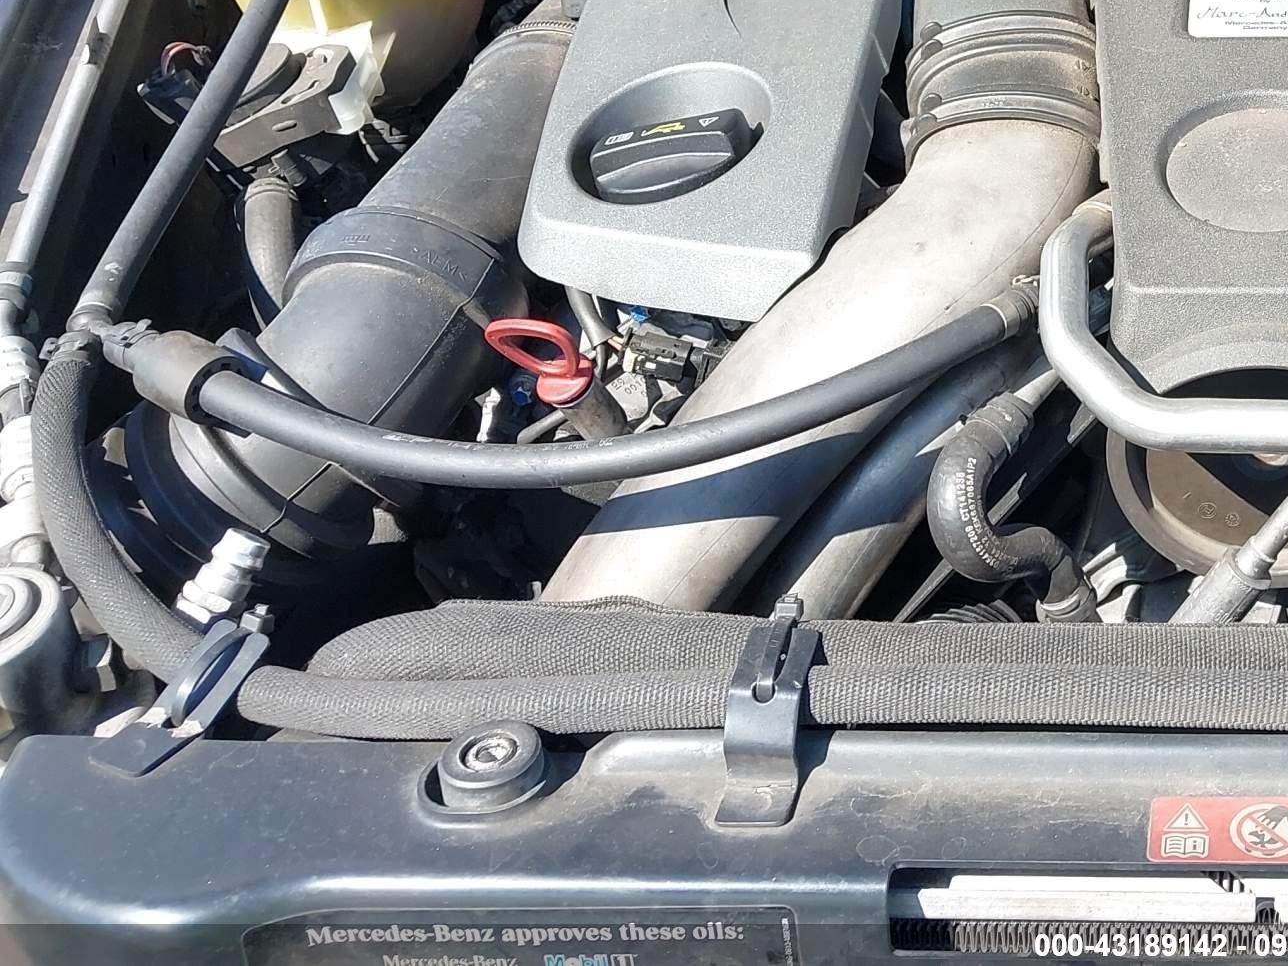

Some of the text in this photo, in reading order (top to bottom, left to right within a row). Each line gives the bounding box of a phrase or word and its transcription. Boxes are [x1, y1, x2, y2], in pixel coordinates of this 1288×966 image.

[306, 921, 745, 946] Mercedes-Benz approves these oils:
